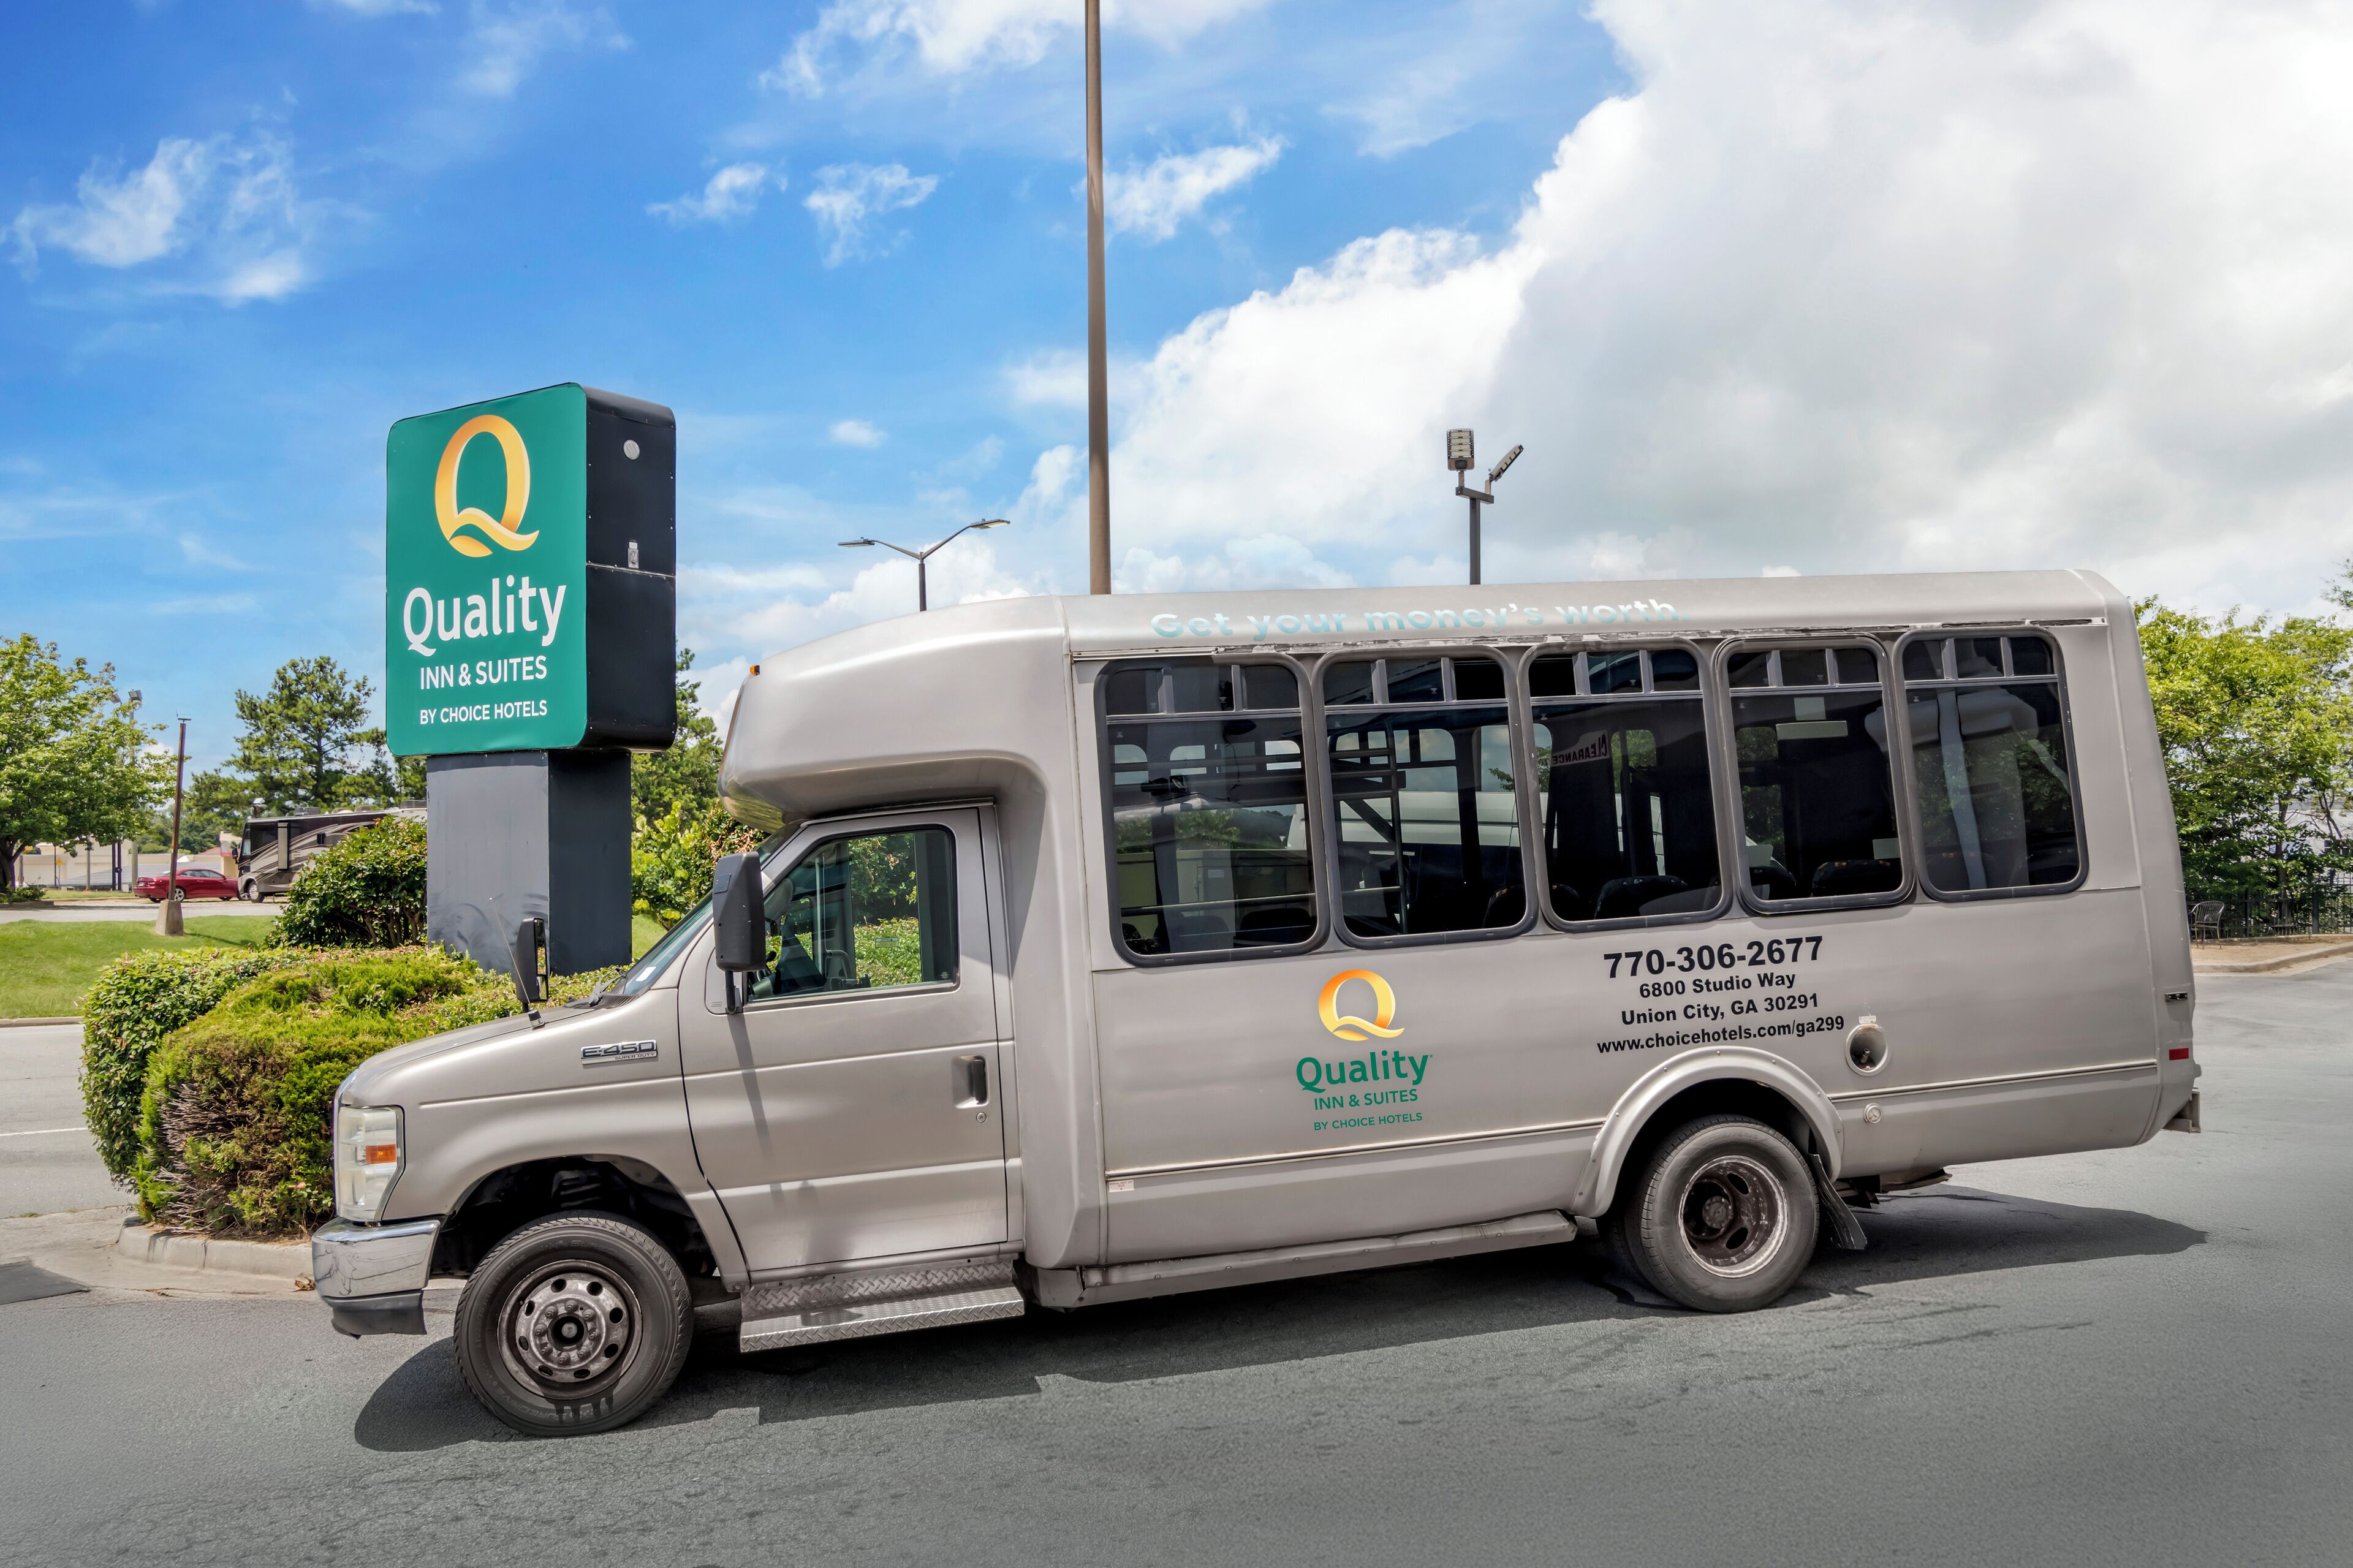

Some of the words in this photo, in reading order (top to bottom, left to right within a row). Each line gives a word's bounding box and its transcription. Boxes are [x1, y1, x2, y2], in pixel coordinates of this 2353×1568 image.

[434, 414, 539, 558] Q
[403, 574, 566, 656] Quality
[1151, 613, 1233, 637] Get
[1246, 613, 1347, 642] your
[1363, 603, 1544, 633] money's
[1555, 599, 1691, 624] worth.
[420, 665, 453, 690] INN
[458, 662, 471, 686] &
[476, 655, 547, 685] SUITES
[420, 708, 436, 725] BY
[440, 705, 490, 723] CHOICE
[494, 699, 547, 719] HOTELS
[1604, 935, 1824, 979] 770-306-2677
[1639, 980, 1686, 998] 6800
[1692, 975, 1752, 993] Studio
[1757, 972, 1795, 989] Way
[1318, 969, 1405, 1041] Q
[1621, 1007, 1677, 1025] Union
[1683, 1003, 1725, 1021] City,
[1731, 999, 1758, 1015] GA
[1764, 993, 1818, 1012] 30291
[582, 1042, 655, 1058] E-450
[1597, 1015, 1844, 1053] www.choicehotels.com/ga299
[1296, 1050, 1429, 1093] Quality
[1314, 1096, 1344, 1110] INN
[1349, 1094, 1360, 1107] &
[1363, 1088, 1418, 1105] SUITES
[1314, 1121, 1328, 1131] BY
[1332, 1116, 1375, 1129] CHOICE
[1378, 1112, 1422, 1124] HOTELS
